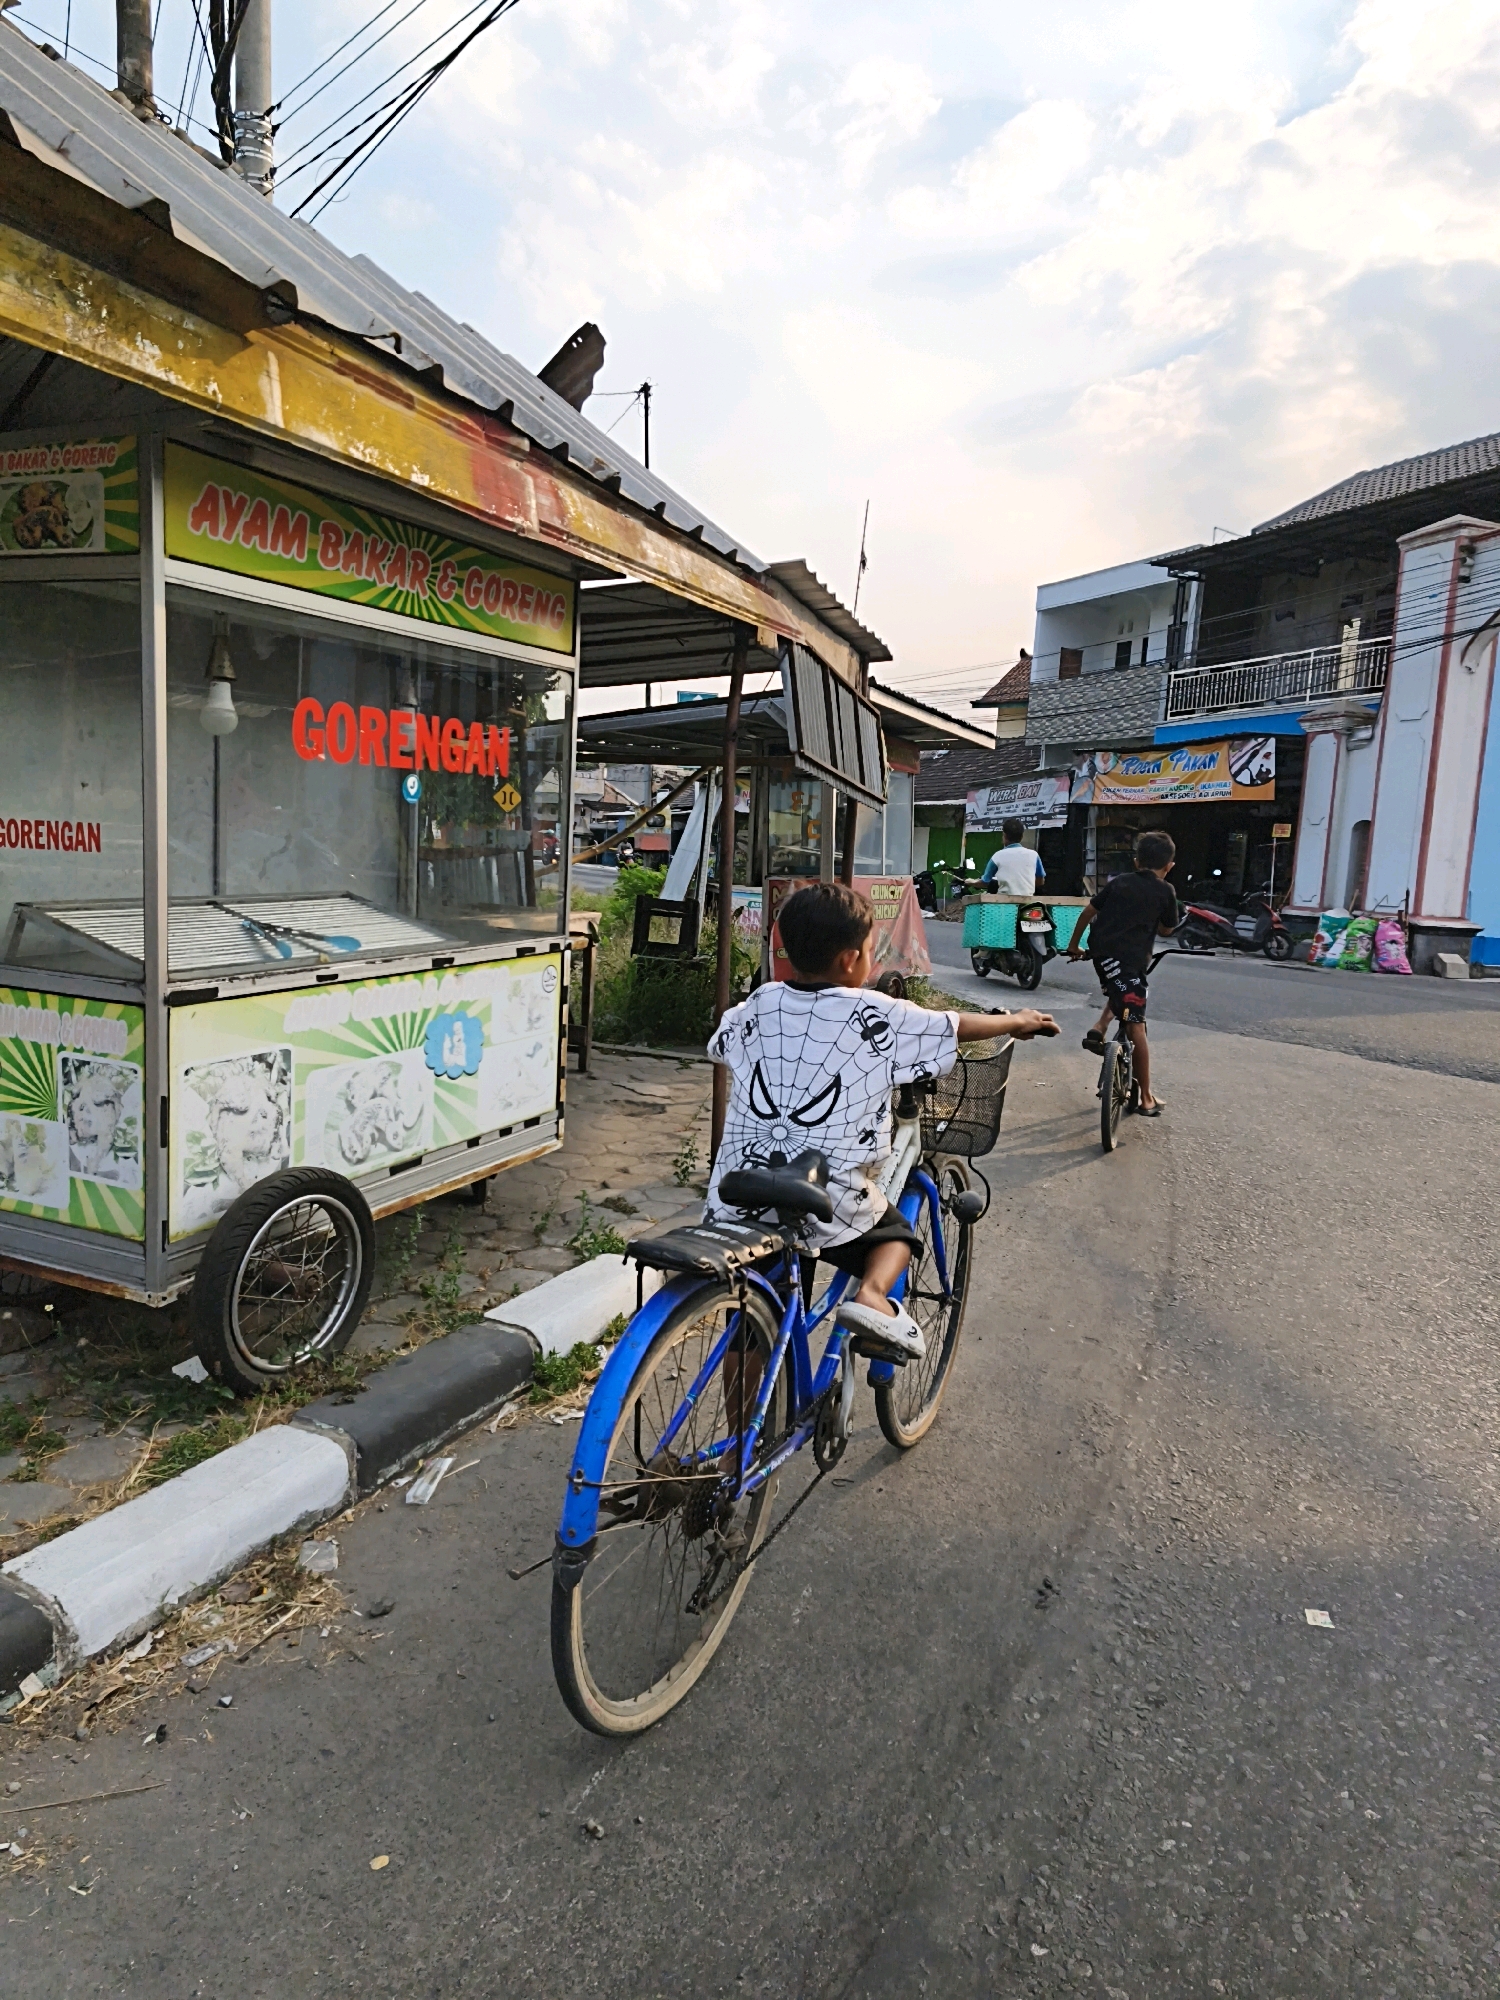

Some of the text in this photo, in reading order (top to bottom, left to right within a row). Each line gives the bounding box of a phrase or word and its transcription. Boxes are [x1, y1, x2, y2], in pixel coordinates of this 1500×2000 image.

[7, 450, 49, 470] BAKAR
[62, 445, 117, 467] GORENG
[189, 483, 567, 631] AYAM BAKAR & GORENG
[292, 697, 511, 778] GORENGAN
[1169, 748, 1220, 773] PAKAN
[874, 903, 899, 919] HICKE
